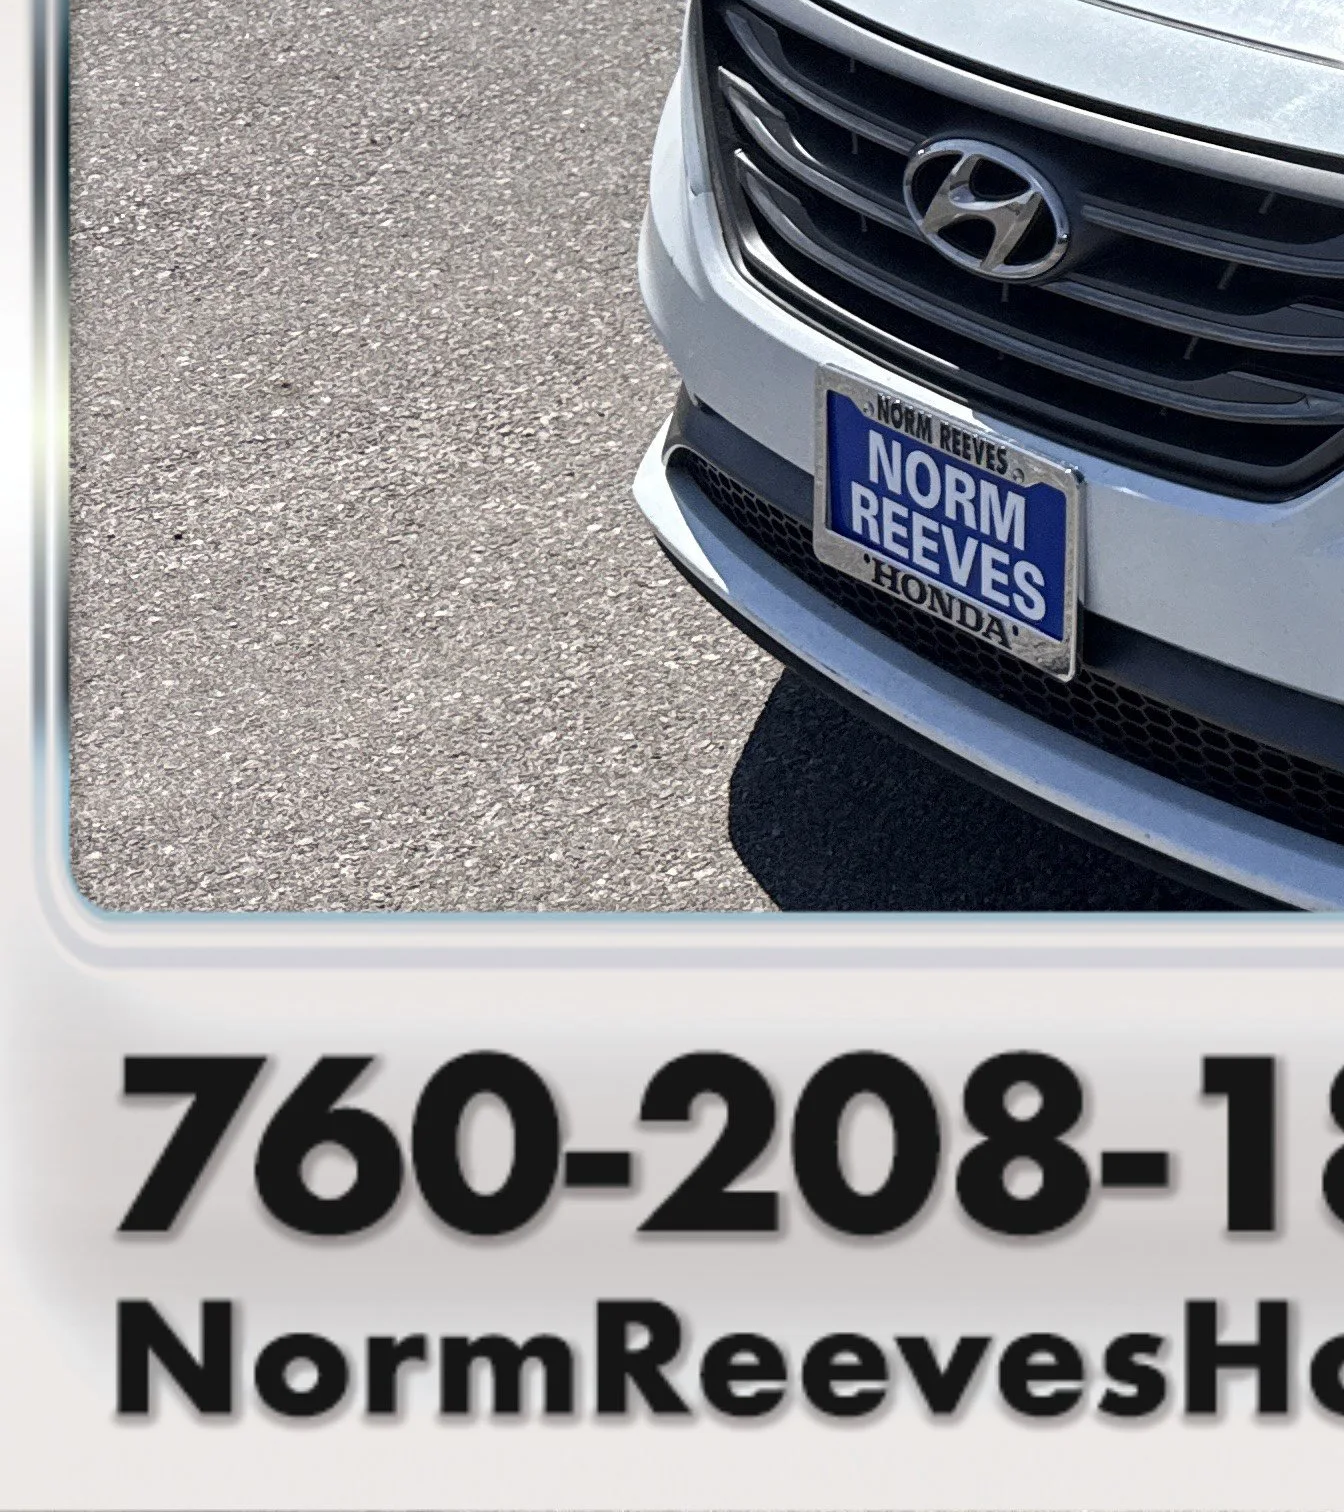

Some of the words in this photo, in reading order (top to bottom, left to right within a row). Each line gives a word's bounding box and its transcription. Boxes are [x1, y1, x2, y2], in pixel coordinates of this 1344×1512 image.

[876, 392, 933, 444] NORM
[939, 421, 1009, 476] REEVES
[868, 429, 1027, 552] NORM
[850, 481, 1047, 622] REEVES
[871, 556, 1013, 651] HONDA
